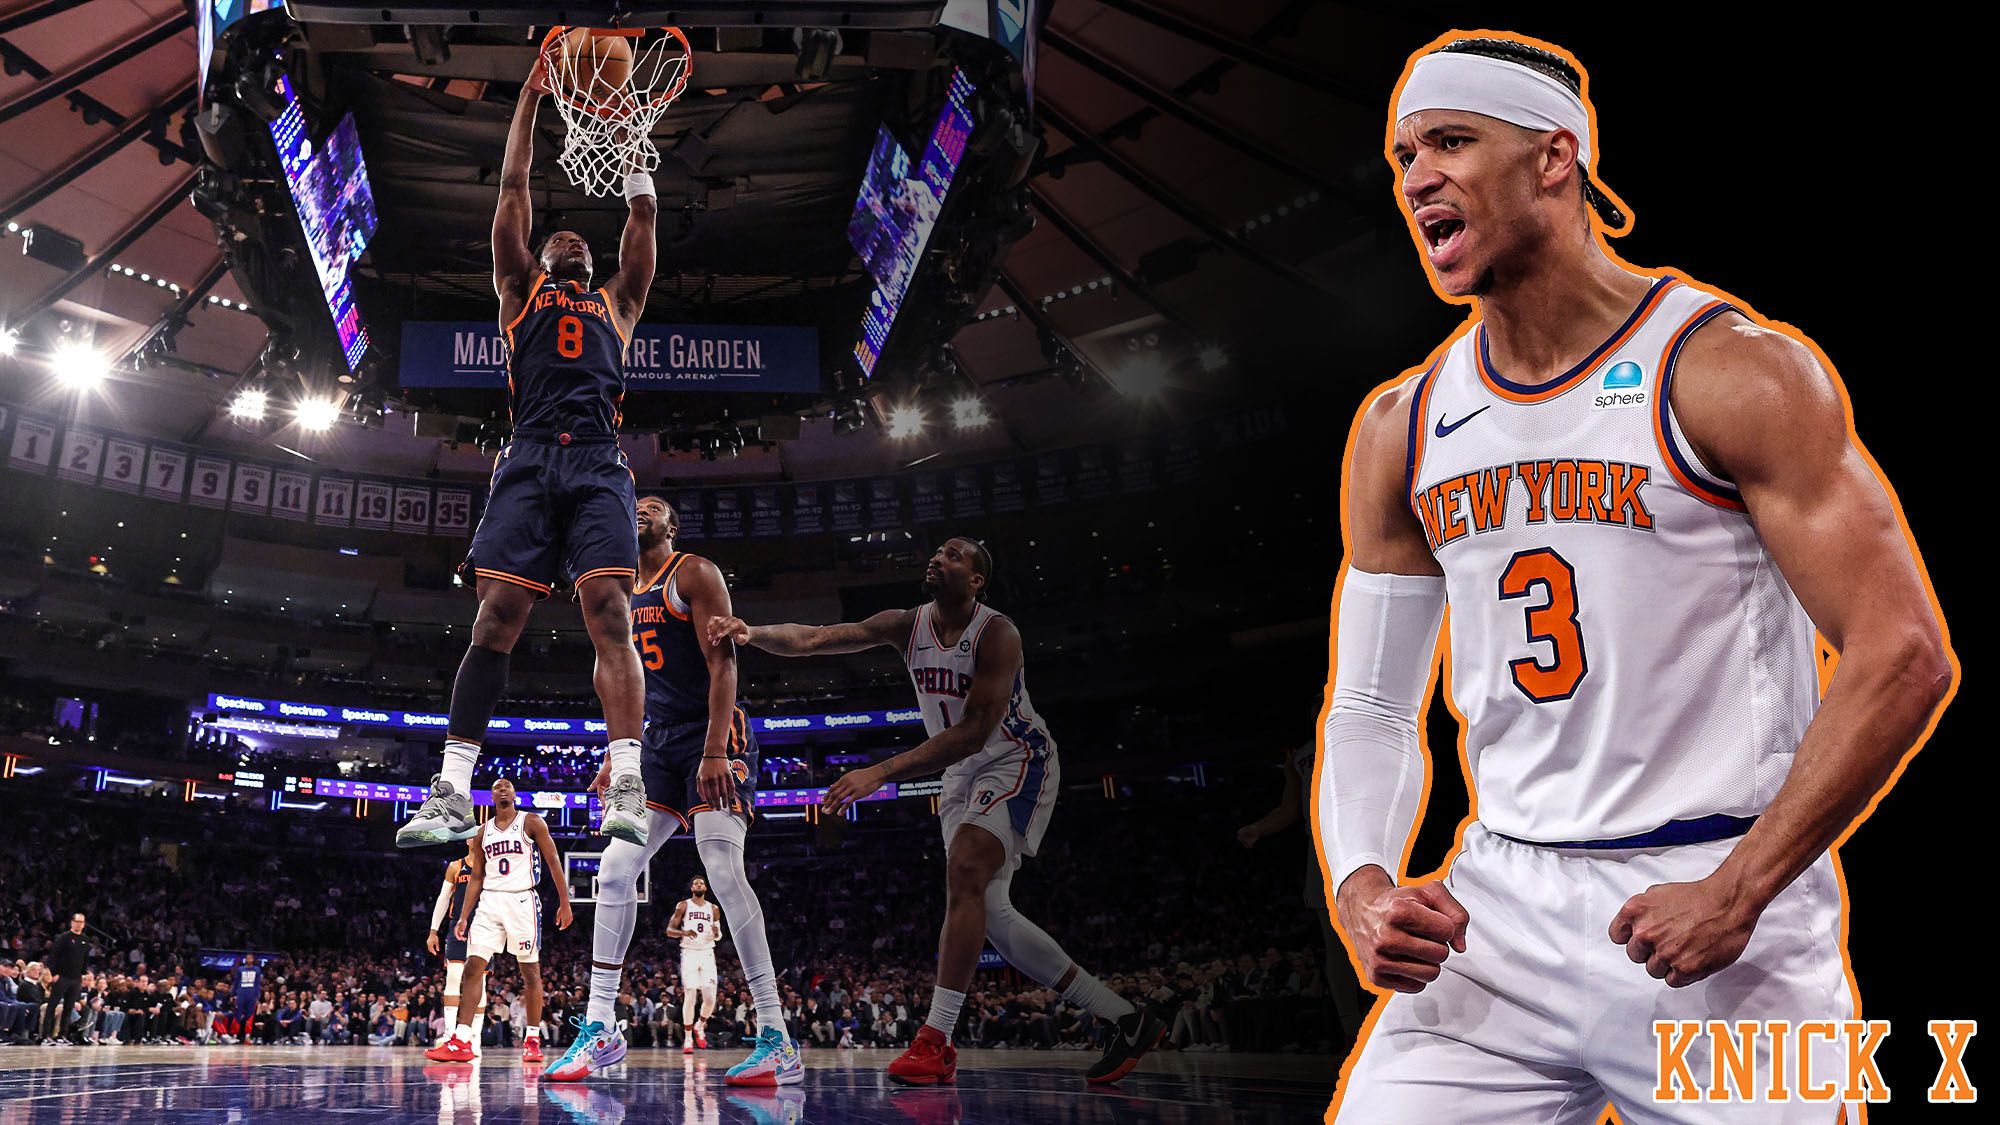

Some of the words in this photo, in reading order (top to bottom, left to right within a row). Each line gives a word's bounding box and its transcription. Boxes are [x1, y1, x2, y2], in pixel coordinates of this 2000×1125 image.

[534, 290, 567, 313] NEW
[566, 297, 608, 323] YORK
[557, 315, 583, 358] 8
[624, 372, 672, 380] FAMOUS
[1594, 392, 1645, 408] sphere
[23, 435, 38, 460] 1
[70, 444, 90, 470] 2
[114, 455, 133, 479] 3
[157, 463, 175, 487] 7
[202, 472, 219, 495] 9
[243, 479, 260, 502] 9
[279, 485, 302, 509] 11
[322, 491, 345, 515] 11
[359, 495, 388, 519] 19
[397, 498, 426, 522] 30
[438, 502, 468, 525] 35
[1417, 464, 1513, 556] NEW
[1516, 459, 1656, 532] YORK
[637, 606, 666, 624] YORK
[1497, 546, 1589, 704] 3
[632, 630, 664, 671] 5
[216, 696, 265, 711] Spectrum
[280, 703, 328, 716] Spectrum
[342, 709, 389, 722] Spectrum
[404, 714, 449, 725] Spectrum
[764, 719, 811, 730] Spectrum
[825, 715, 872, 727] Spectrum
[886, 711, 923, 723] Spectru
[525, 720, 571, 731] Spectrum
[973, 789, 995, 806] 76
[484, 840, 524, 859] PHILA
[499, 858, 510, 875] 0
[689, 911, 711, 922] PHILA
[697, 923, 704, 933] 8
[519, 939, 531, 951] 76
